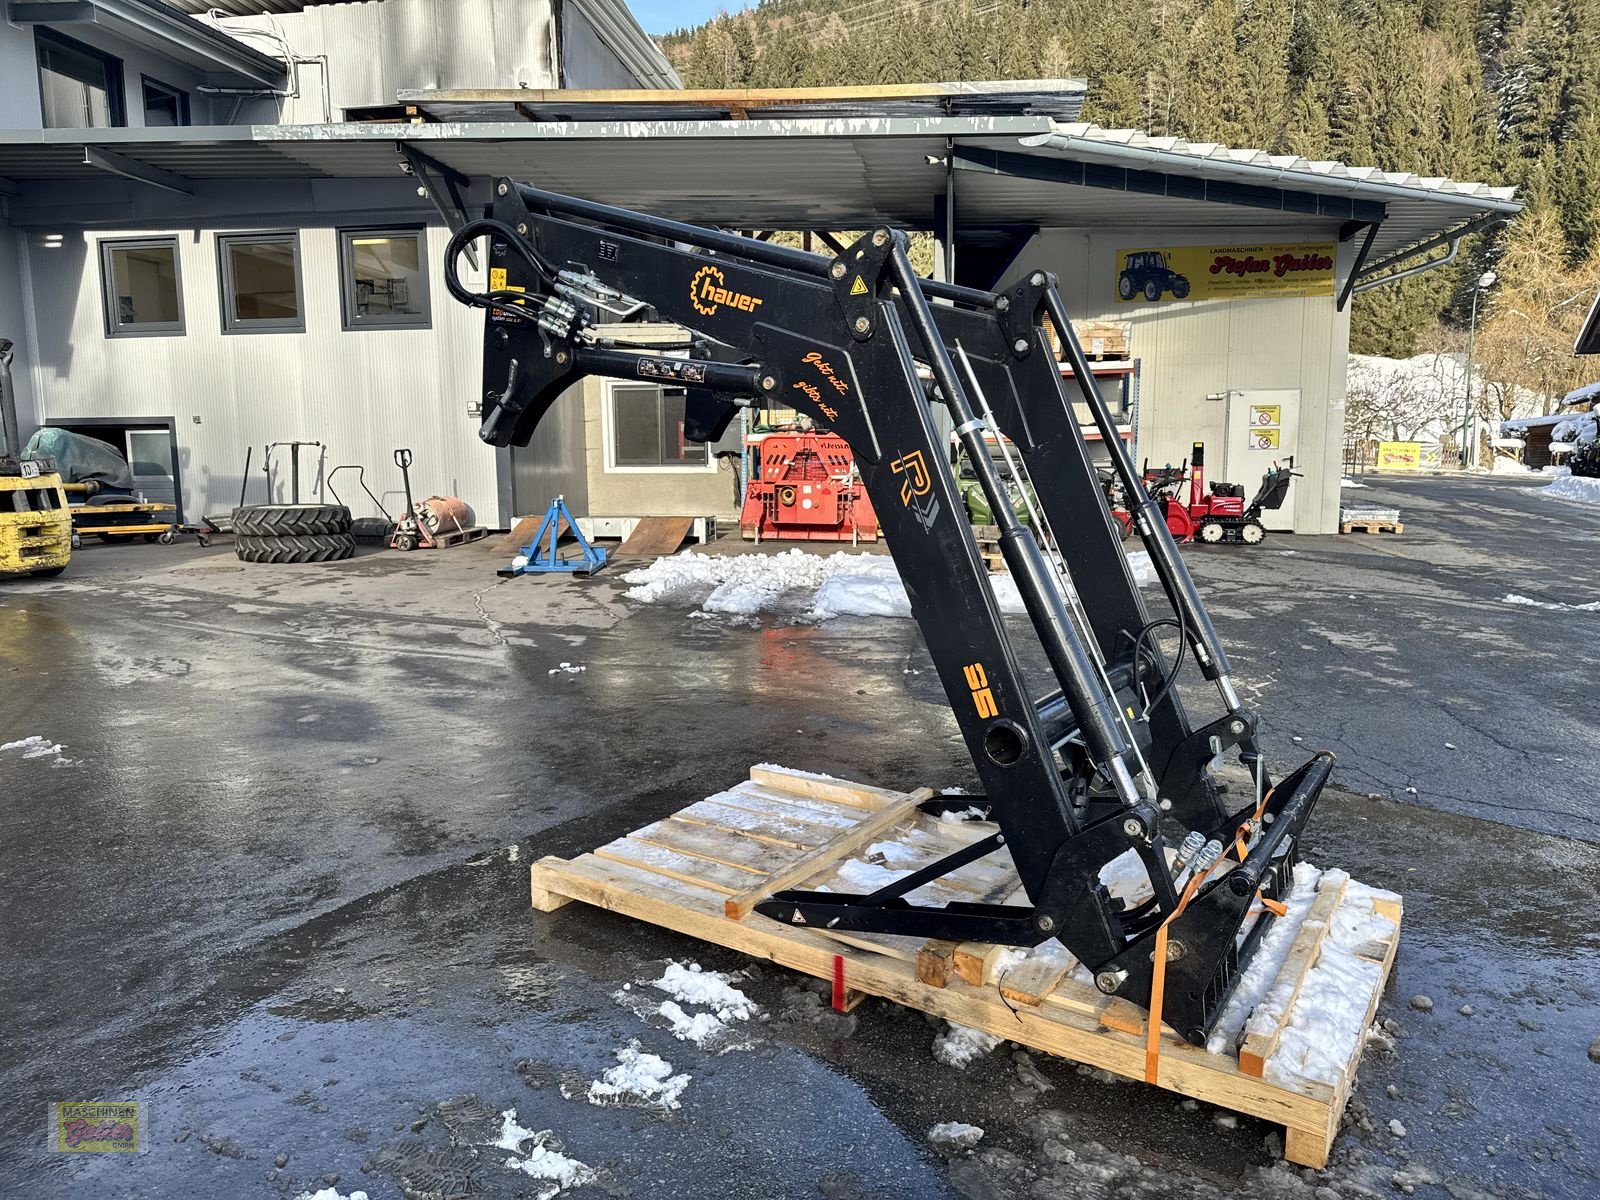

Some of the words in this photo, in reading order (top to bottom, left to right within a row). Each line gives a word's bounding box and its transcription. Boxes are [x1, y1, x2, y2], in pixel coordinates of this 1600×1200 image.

[1209, 255, 1270, 277] Stefan
[700, 277, 763, 313] hauer
[801, 352, 832, 376] Geht
[792, 381, 822, 404] gibts
